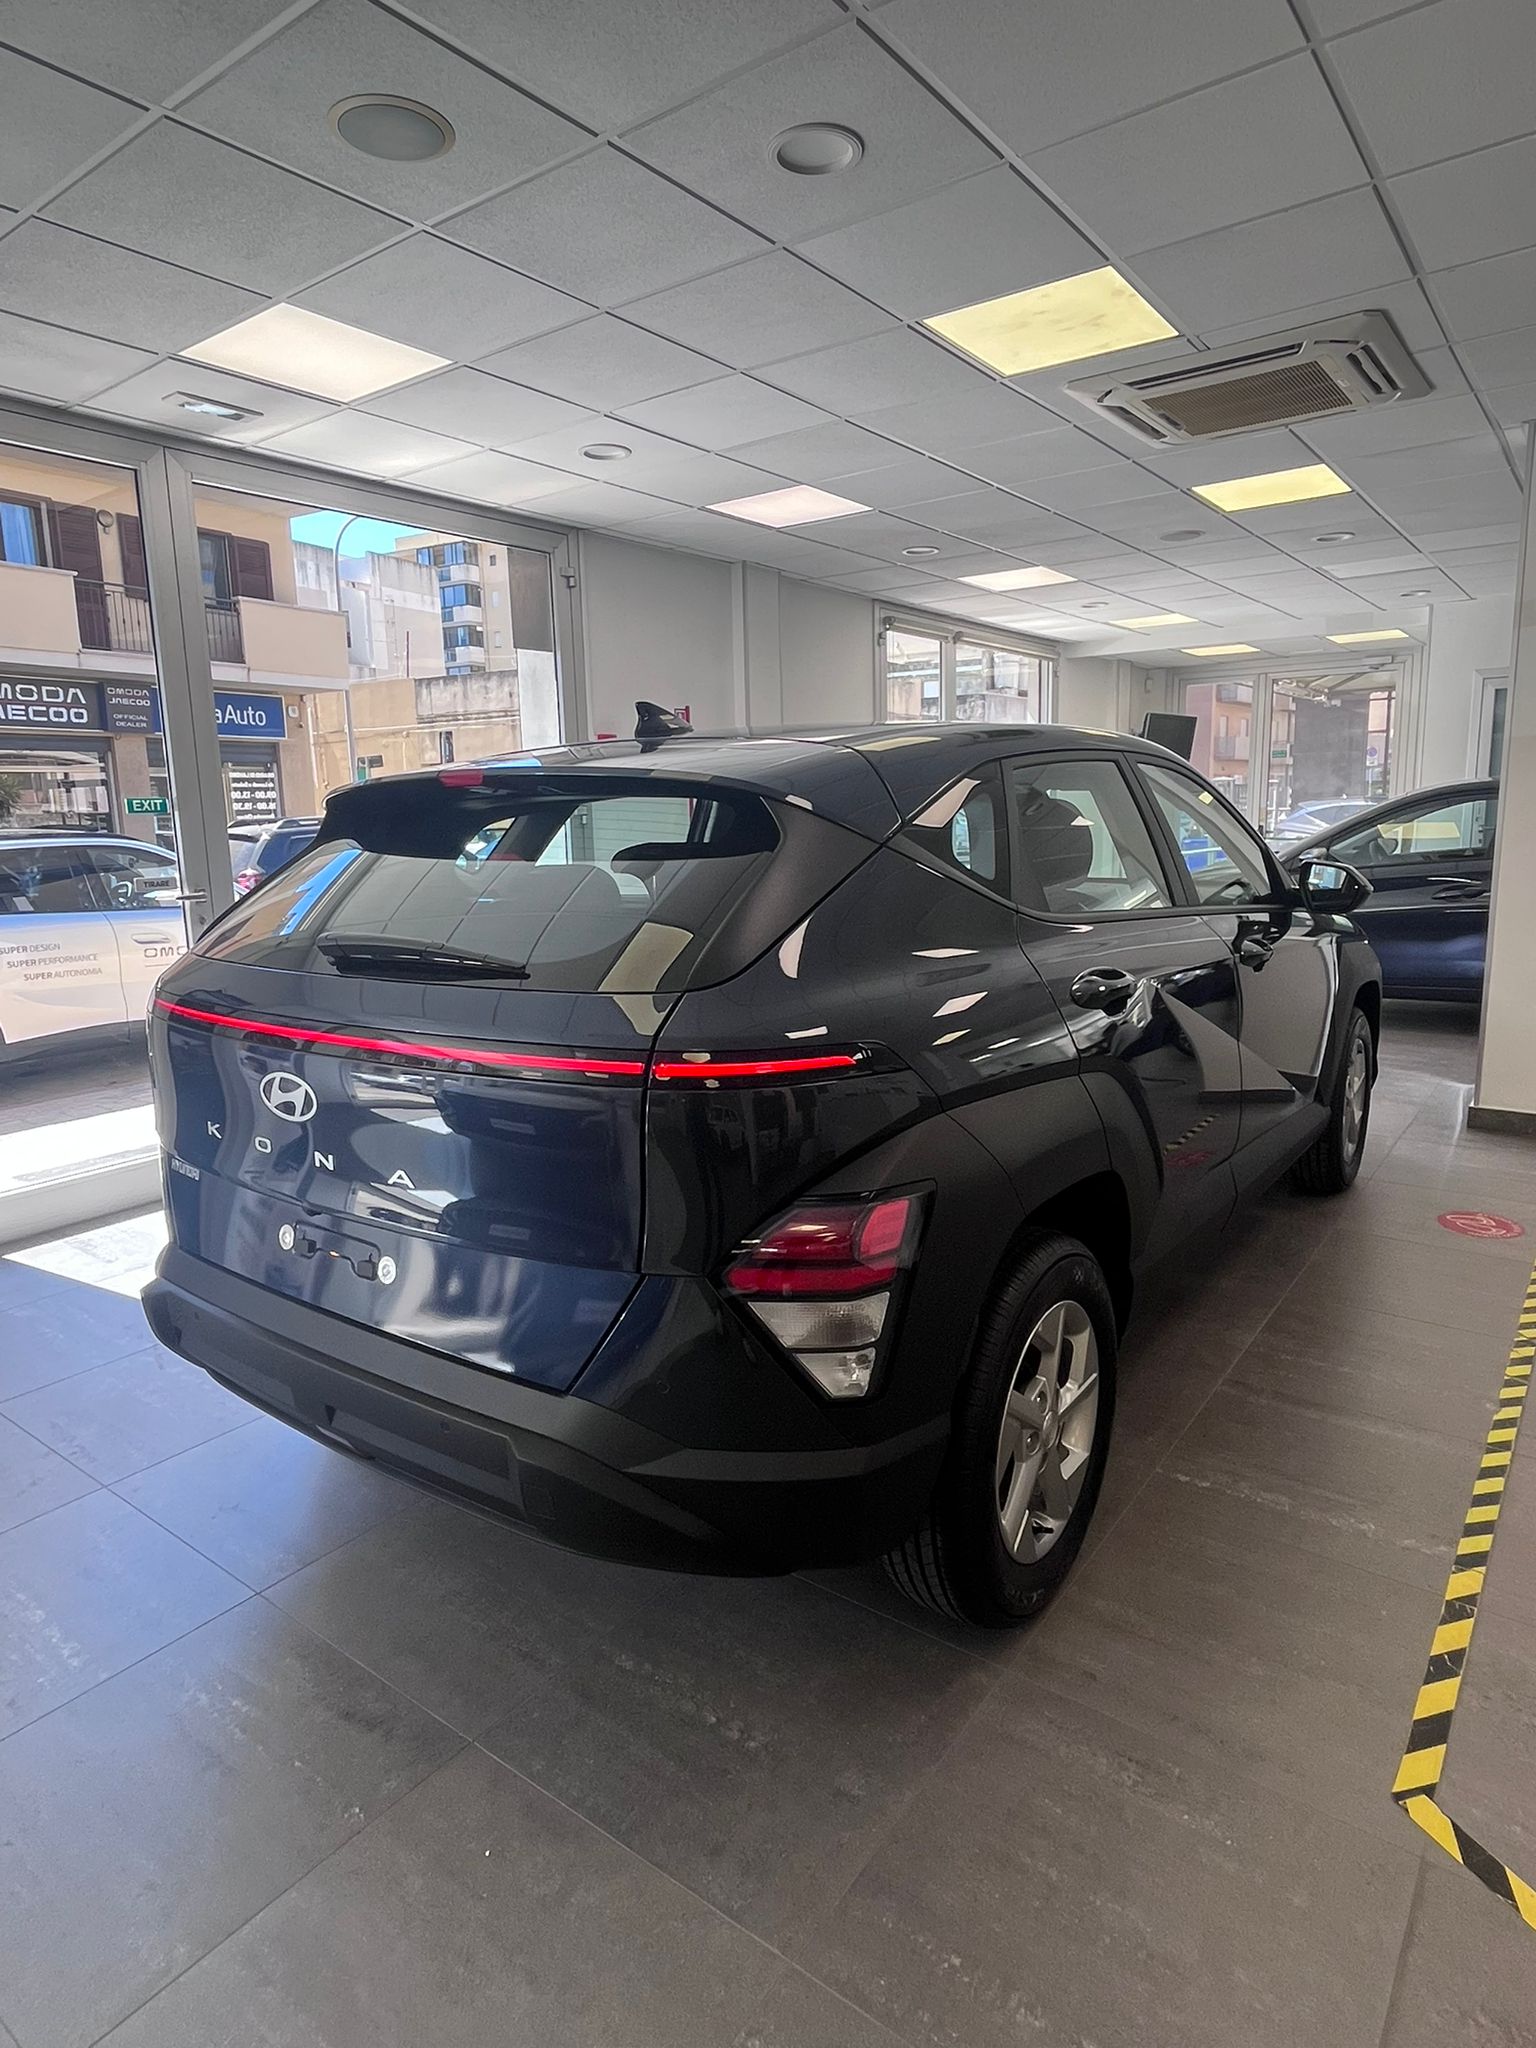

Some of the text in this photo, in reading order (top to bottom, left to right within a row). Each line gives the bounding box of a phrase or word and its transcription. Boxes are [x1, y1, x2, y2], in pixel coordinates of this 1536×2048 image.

[106, 687, 150, 697] OMODA
[109, 697, 151, 706] JAECOO
[0, 704, 88, 723] ECOO
[113, 713, 148, 721] OFFICIAL
[115, 720, 148, 728] DEALER
[132, 799, 163, 812] EXIT
[143, 880, 170, 889] TIRARE
[0, 943, 61, 956] SUPER DESIGN
[7, 953, 98, 969] SUPER PERFORMANCE
[23, 967, 103, 981] SUPER AUTONOMIA
[206, 1120, 416, 1190] KONA
